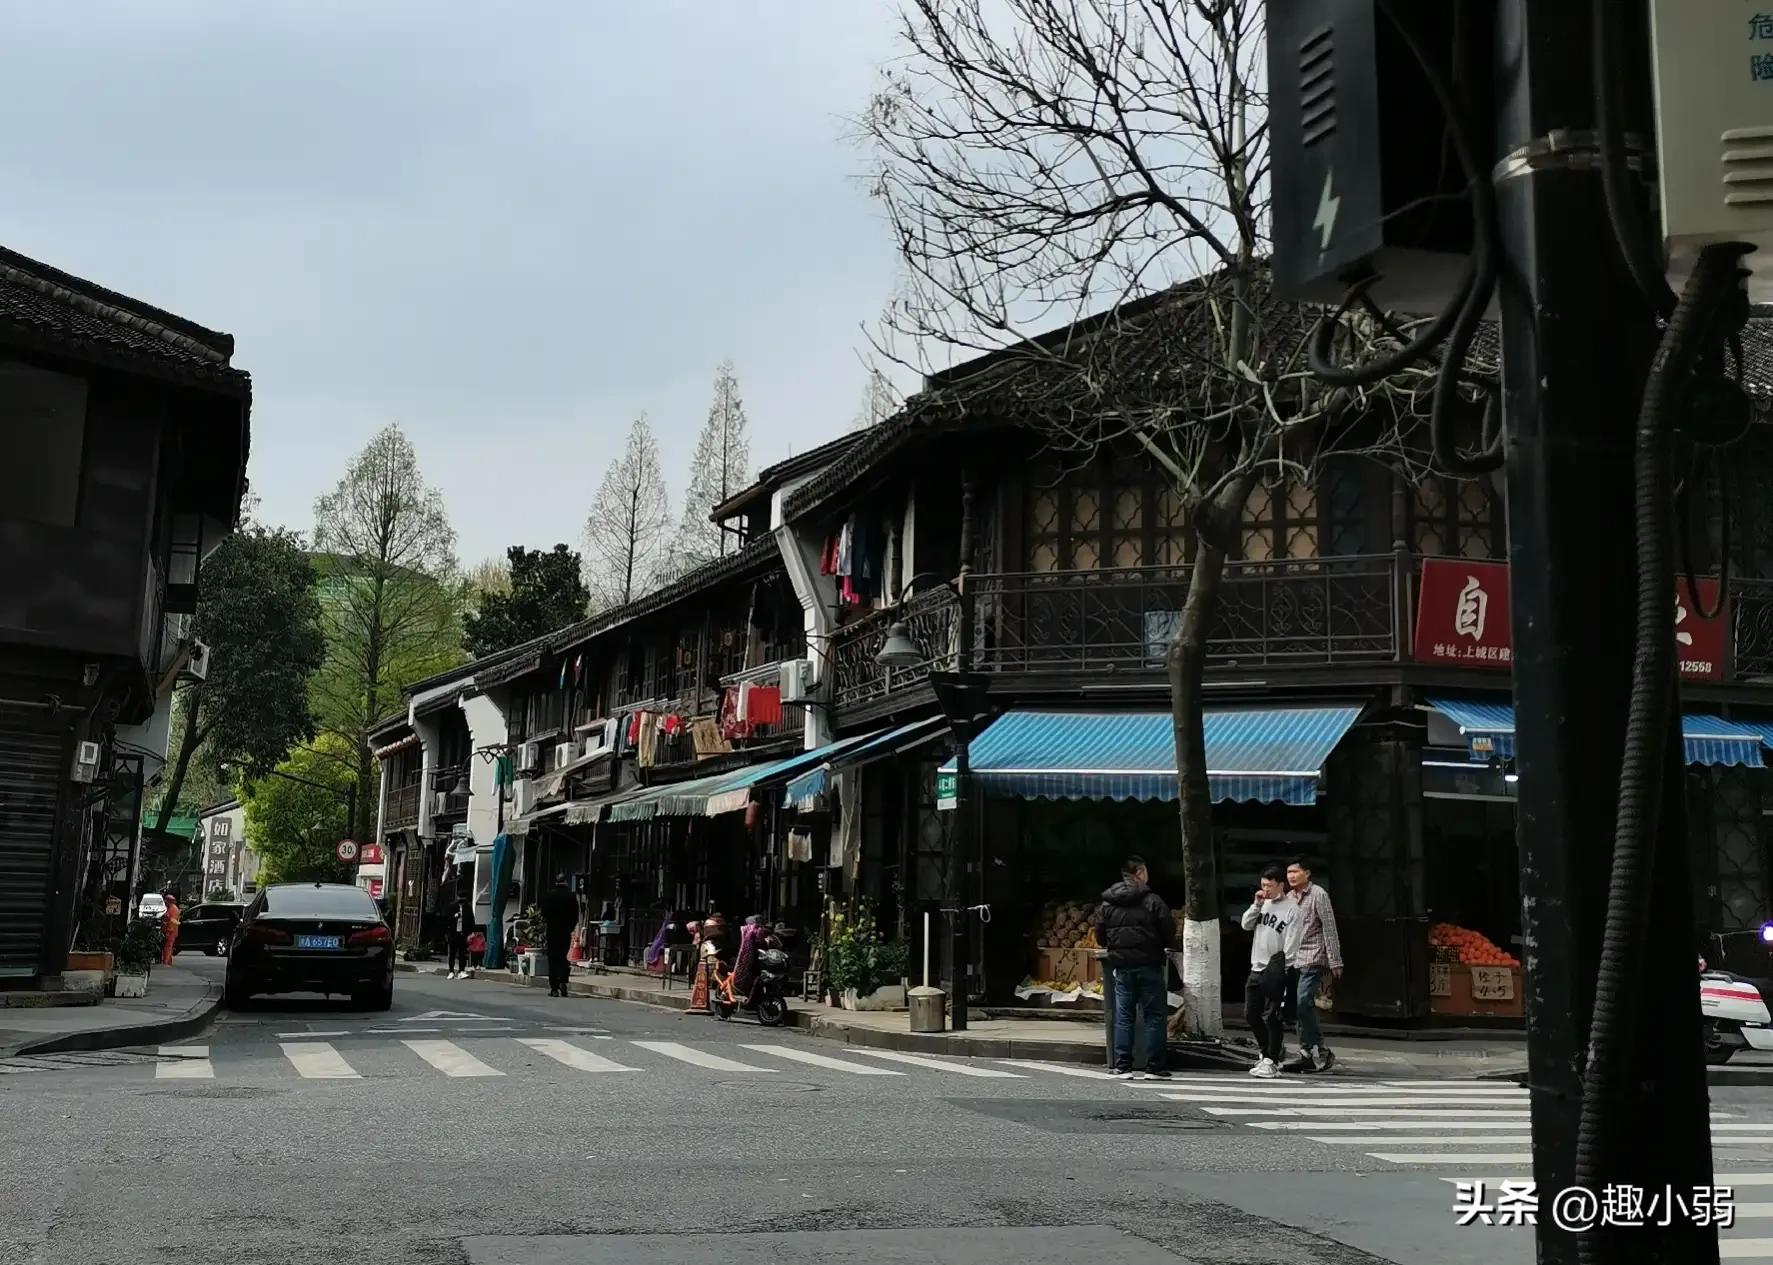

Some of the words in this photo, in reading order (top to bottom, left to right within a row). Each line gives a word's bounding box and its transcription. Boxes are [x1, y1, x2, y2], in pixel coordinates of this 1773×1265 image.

[1455, 575, 1487, 641] 自
[208, 822, 228, 893] 如家酒店
[341, 845, 352, 855] 30
